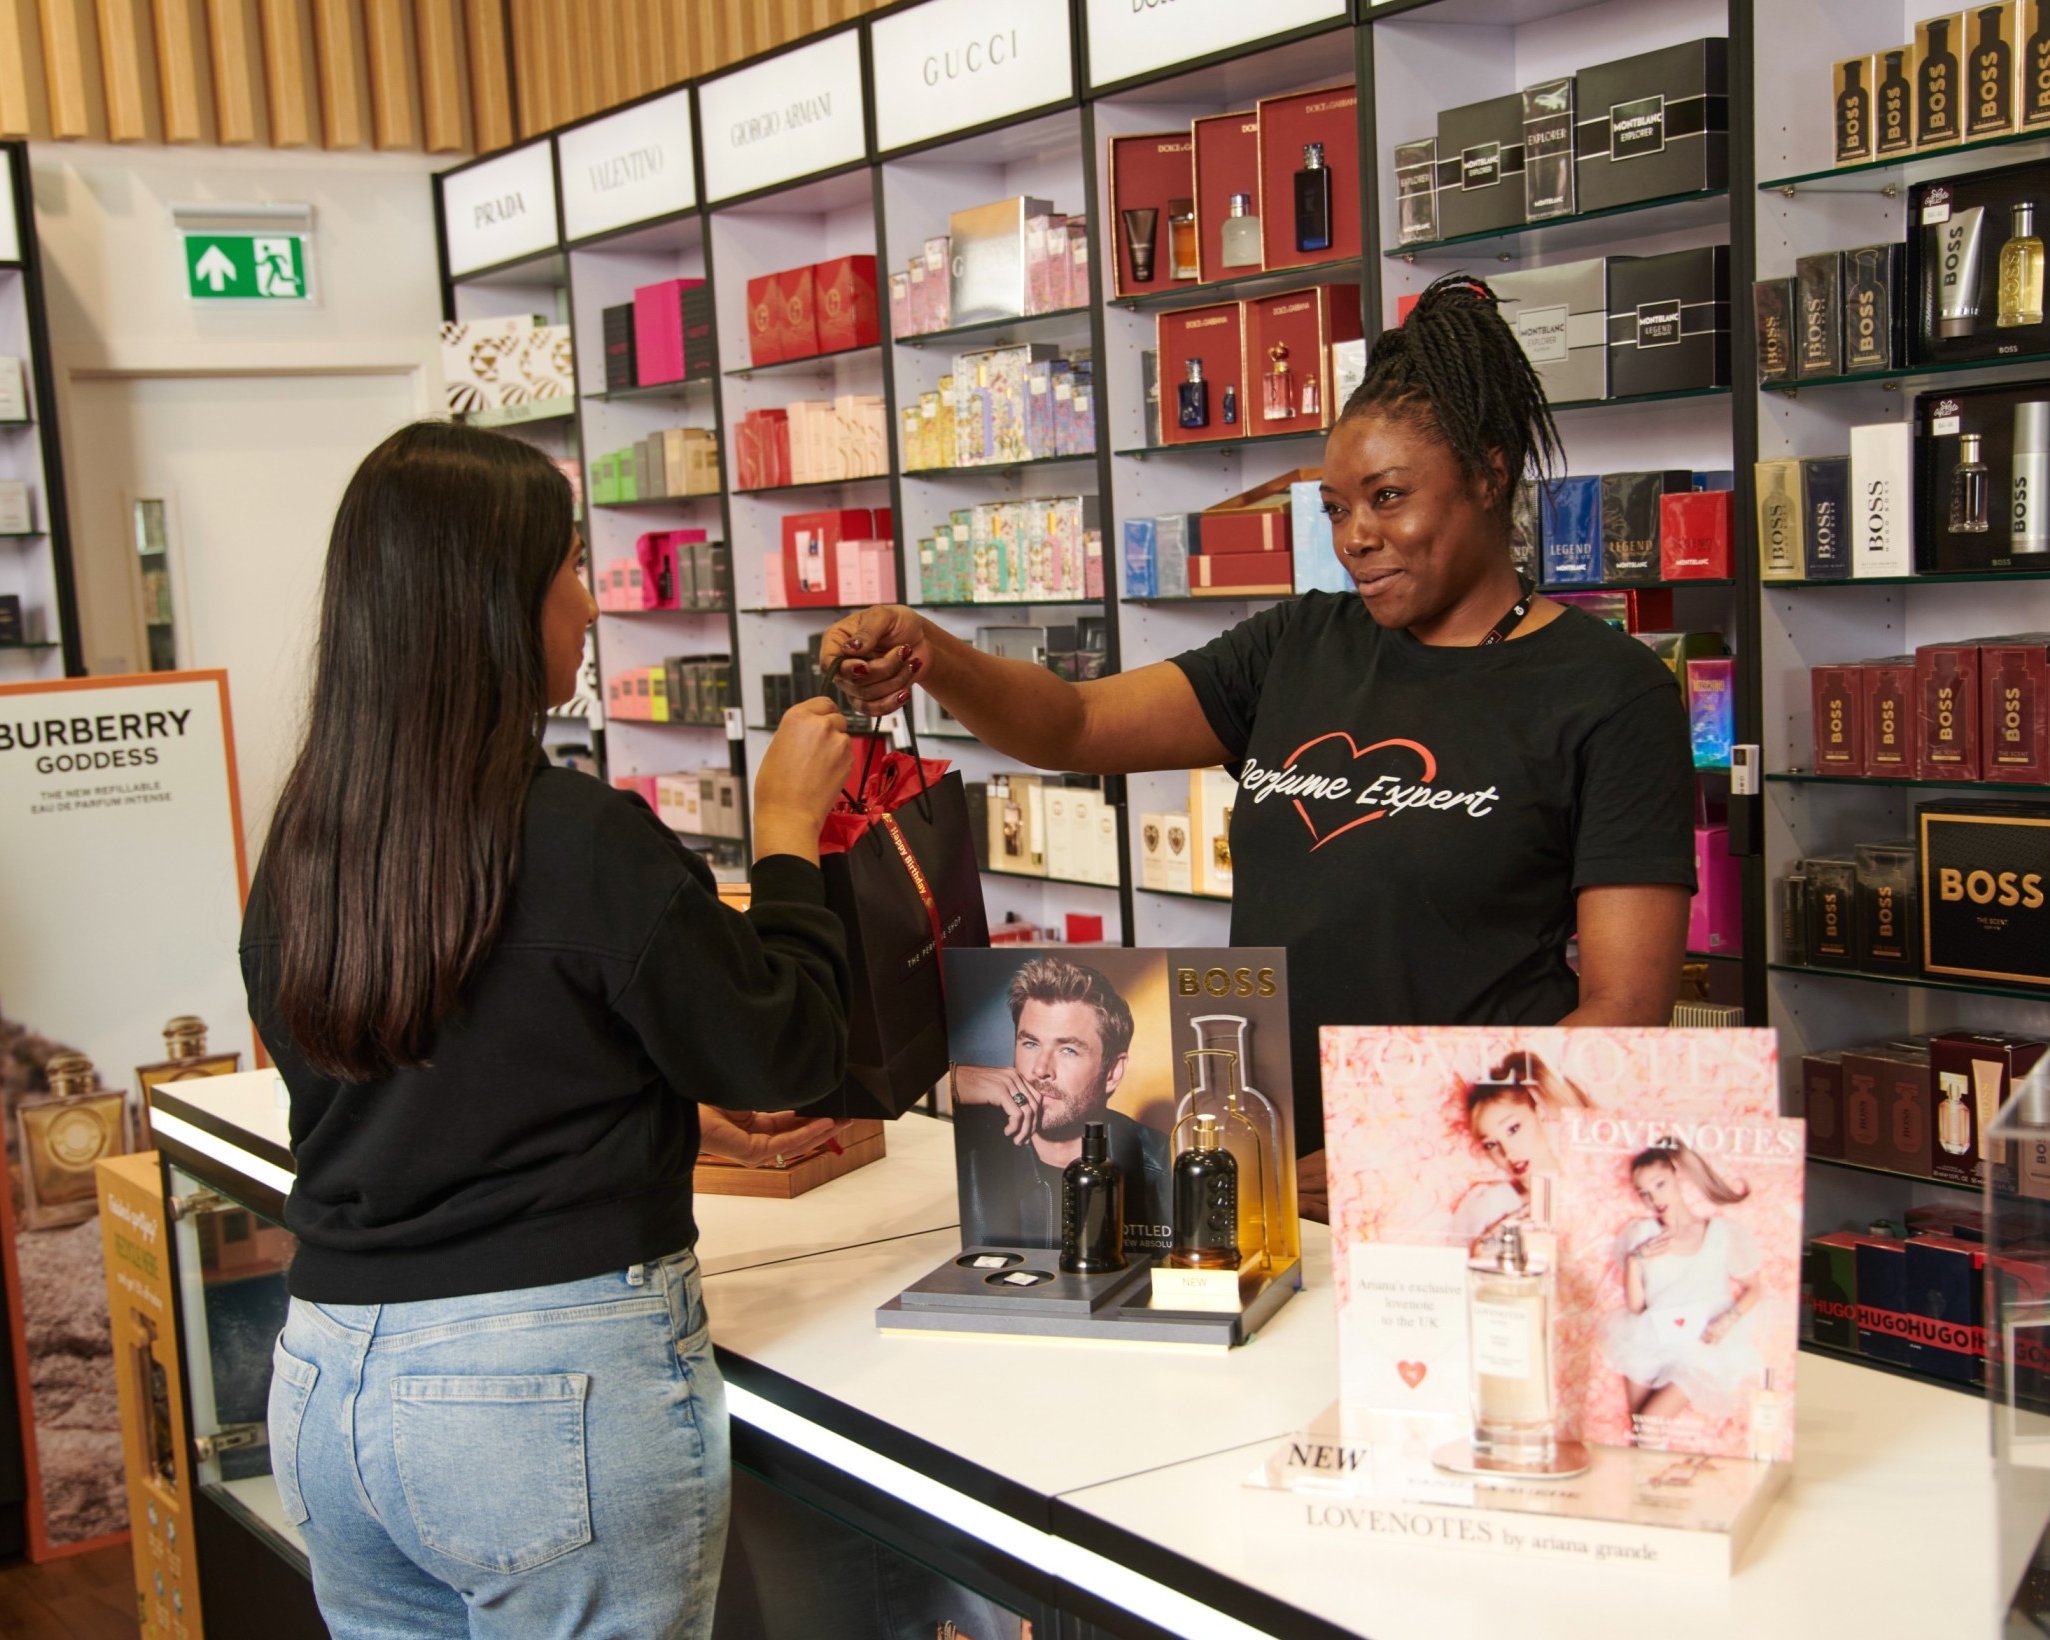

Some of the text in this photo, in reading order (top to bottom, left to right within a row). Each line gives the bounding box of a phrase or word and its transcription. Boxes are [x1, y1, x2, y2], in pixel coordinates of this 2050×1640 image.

[924, 29, 1017, 87] GUCCI
[1929, 62, 1946, 129] BOSS
[1981, 50, 1998, 119] BOSS
[730, 92, 833, 149] GIORGIO ARMANI
[1613, 112, 1663, 133] MONTBLANC
[1620, 126, 1654, 142] EXPLORER
[1846, 95, 1859, 149] BOSS
[1887, 86, 1901, 141] BOSS
[1527, 127, 1568, 146] EXPLORER
[588, 145, 664, 194] VALENTINO
[1400, 173, 1430, 188] EXPLORER
[1463, 155, 1499, 170] MONTBLANC
[474, 192, 526, 230] PRADA
[1943, 225, 1964, 287] BOSS
[1520, 323, 1565, 338] MONTBLANC
[1639, 312, 1679, 326] MONTBLANC
[1645, 324, 1673, 335] LEGEND
[1766, 316, 1778, 364] BOSS
[1808, 298, 1822, 357] BOSS
[1860, 290, 1874, 352] BOSS
[1999, 345, 2018, 354] BOSS
[1868, 480, 1884, 552] BOSS
[2014, 476, 2027, 533] BOSS
[1550, 543, 1592, 556] LEGEND
[1609, 539, 1653, 552] LEGEND
[1770, 504, 1784, 560] BOSS
[1817, 501, 1831, 559] BOSS
[0, 708, 192, 751] BURBERRY
[1830, 699, 1842, 744] BOSS
[1882, 700, 1895, 745] BOSS
[1938, 687, 1953, 741] BOSS
[2005, 687, 2021, 742] BOSS
[35, 746, 160, 775] GODDESS
[31, 791, 173, 815] EAU DE PARFUM INTENSE
[41, 780, 162, 802] THE NEW REFILLABLE
[1241, 758, 1500, 818] Perfume Expert
[890, 825, 928, 895] Happy Birthday
[1939, 867, 2045, 910] BOSS
[1824, 893, 1838, 937] BOSS
[1878, 886, 1893, 938] BOSS
[907, 953, 920, 969] THE
[947, 915, 962, 935] SHOP
[1177, 966, 1278, 999] BOSS
[1569, 1115, 1799, 1156] LOVENOTES
[1182, 1276, 1208, 1288] NEW
[1357, 1279, 1462, 1296] Ariana's exclusive
[1381, 1315, 1440, 1329] to the UK
[1385, 1297, 1435, 1312] lovenote
[1813, 1299, 1857, 1321] HUGO
[1857, 1308, 1908, 1333] HUGO
[1907, 1320, 1969, 1349] HUGO
[1286, 1442, 1369, 1473] NEW
[1304, 1503, 1660, 1563] LOVENOTES by ariana grande
